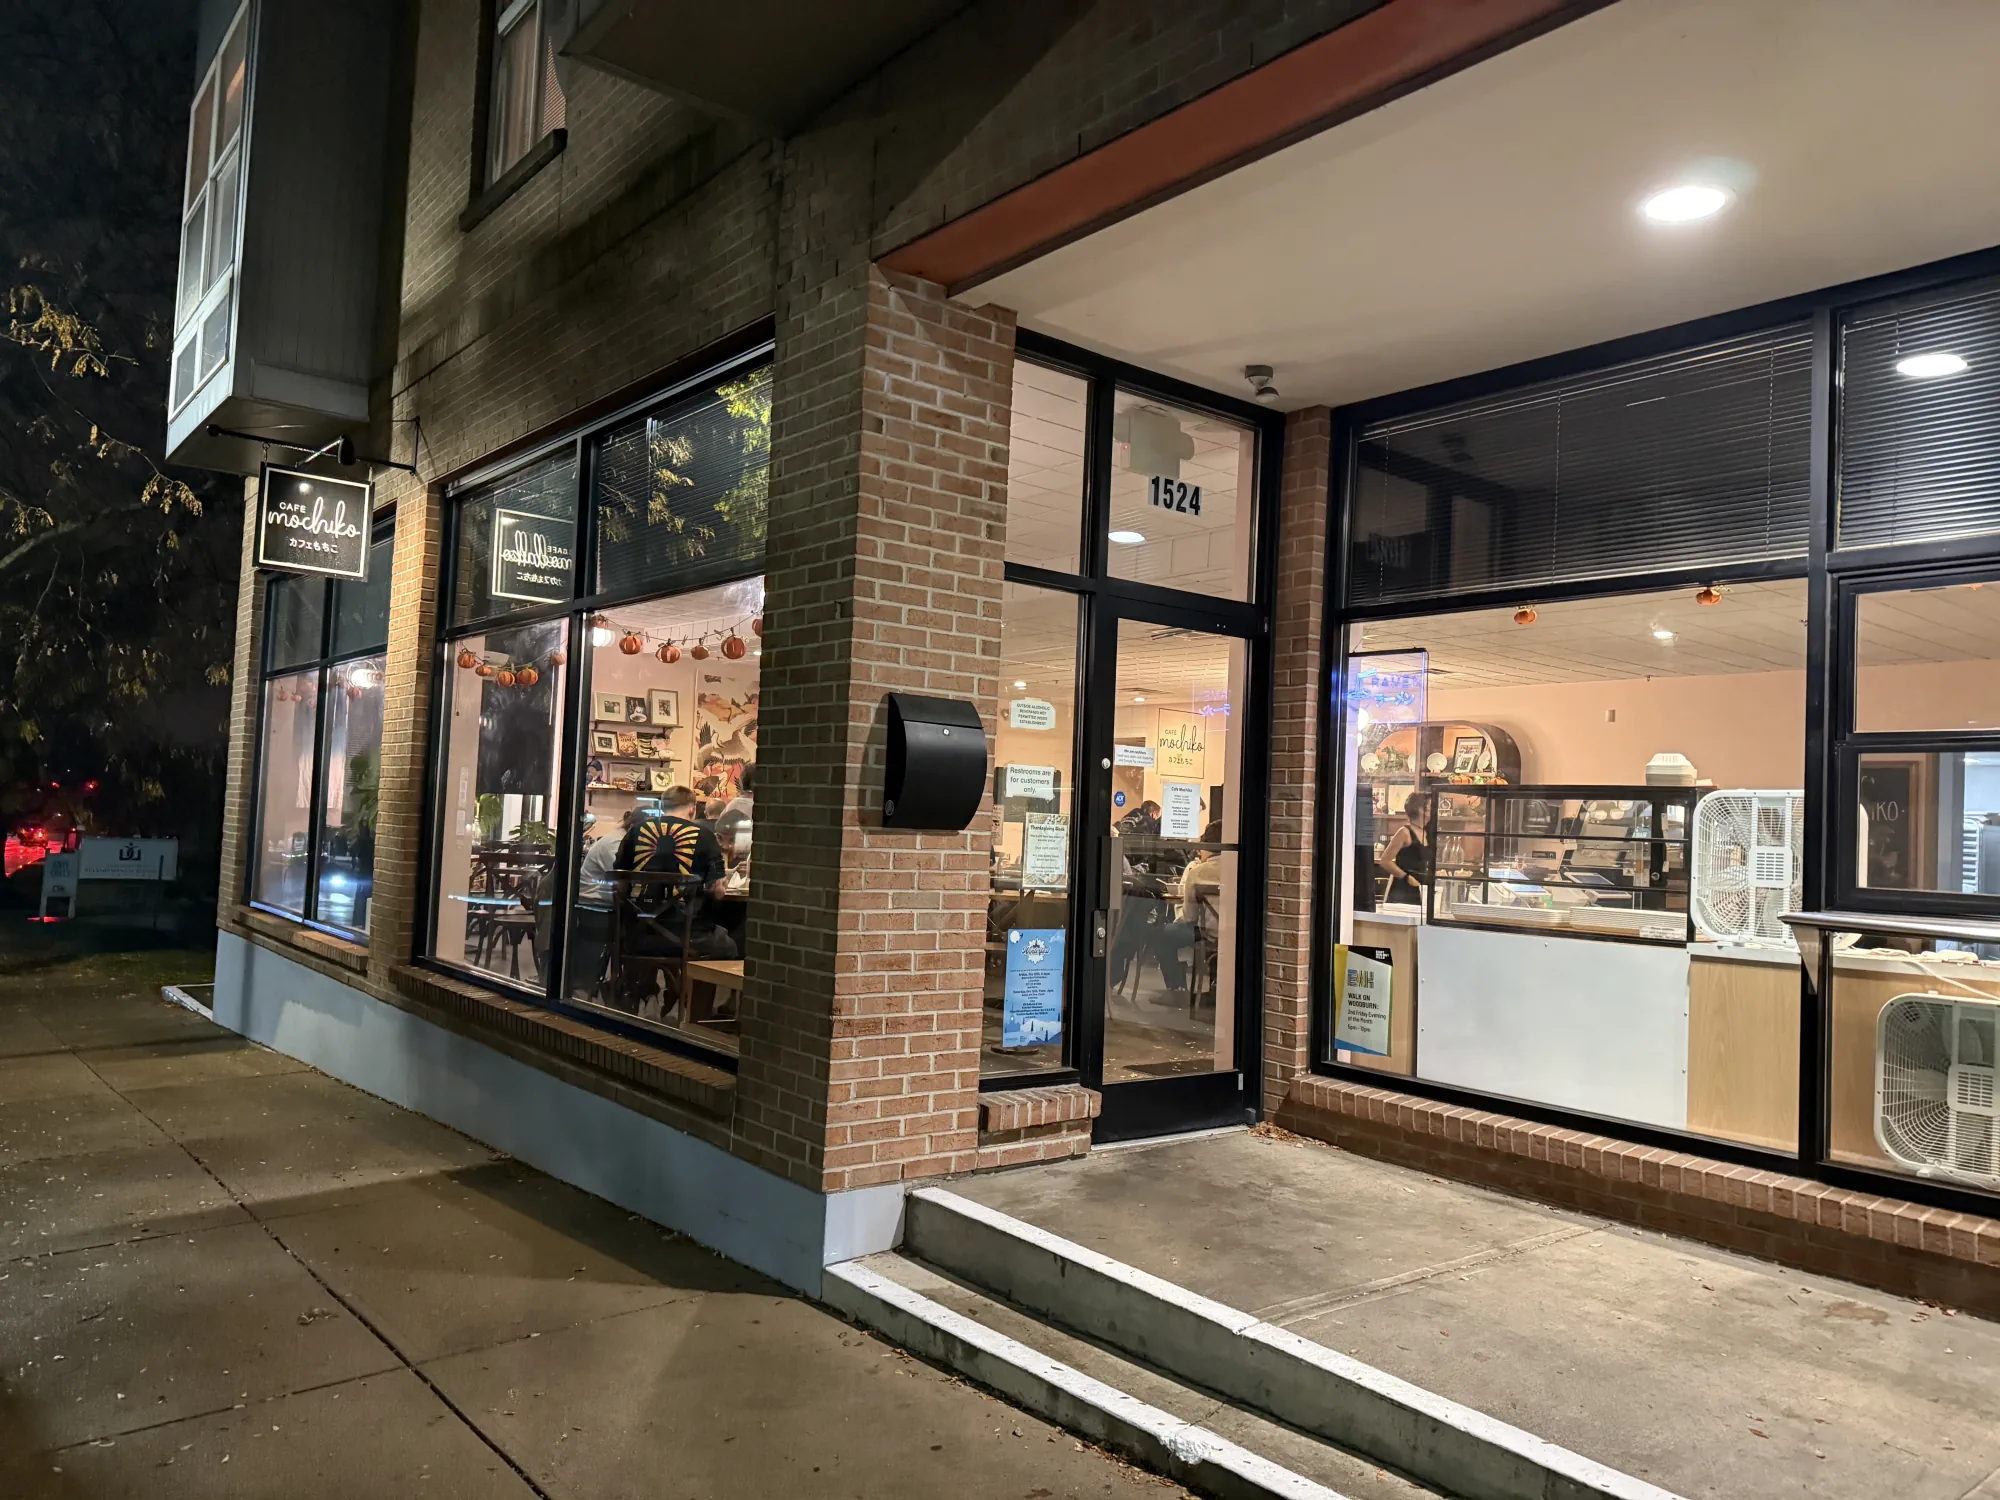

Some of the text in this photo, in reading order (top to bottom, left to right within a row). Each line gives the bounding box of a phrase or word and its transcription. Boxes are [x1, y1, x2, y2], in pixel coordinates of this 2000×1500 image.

[1151, 475, 1201, 516] 1524
[279, 501, 307, 514] CAFE
[268, 496, 361, 539] mochiko
[289, 537, 339, 554] カフェもちこ
[1374, 691, 1416, 708] ラーメン
[1159, 723, 1205, 754] mochiko
[1010, 766, 1042, 776] Restrooms
[1020, 777, 1051, 785] customers
[1023, 787, 1037, 795] only.
[1347, 992, 1362, 1000] WALK
[1347, 999, 1379, 1010] WOODBURN:
[1355, 1010, 1368, 1018] Friday
[1368, 1012, 1387, 1021] Evening
